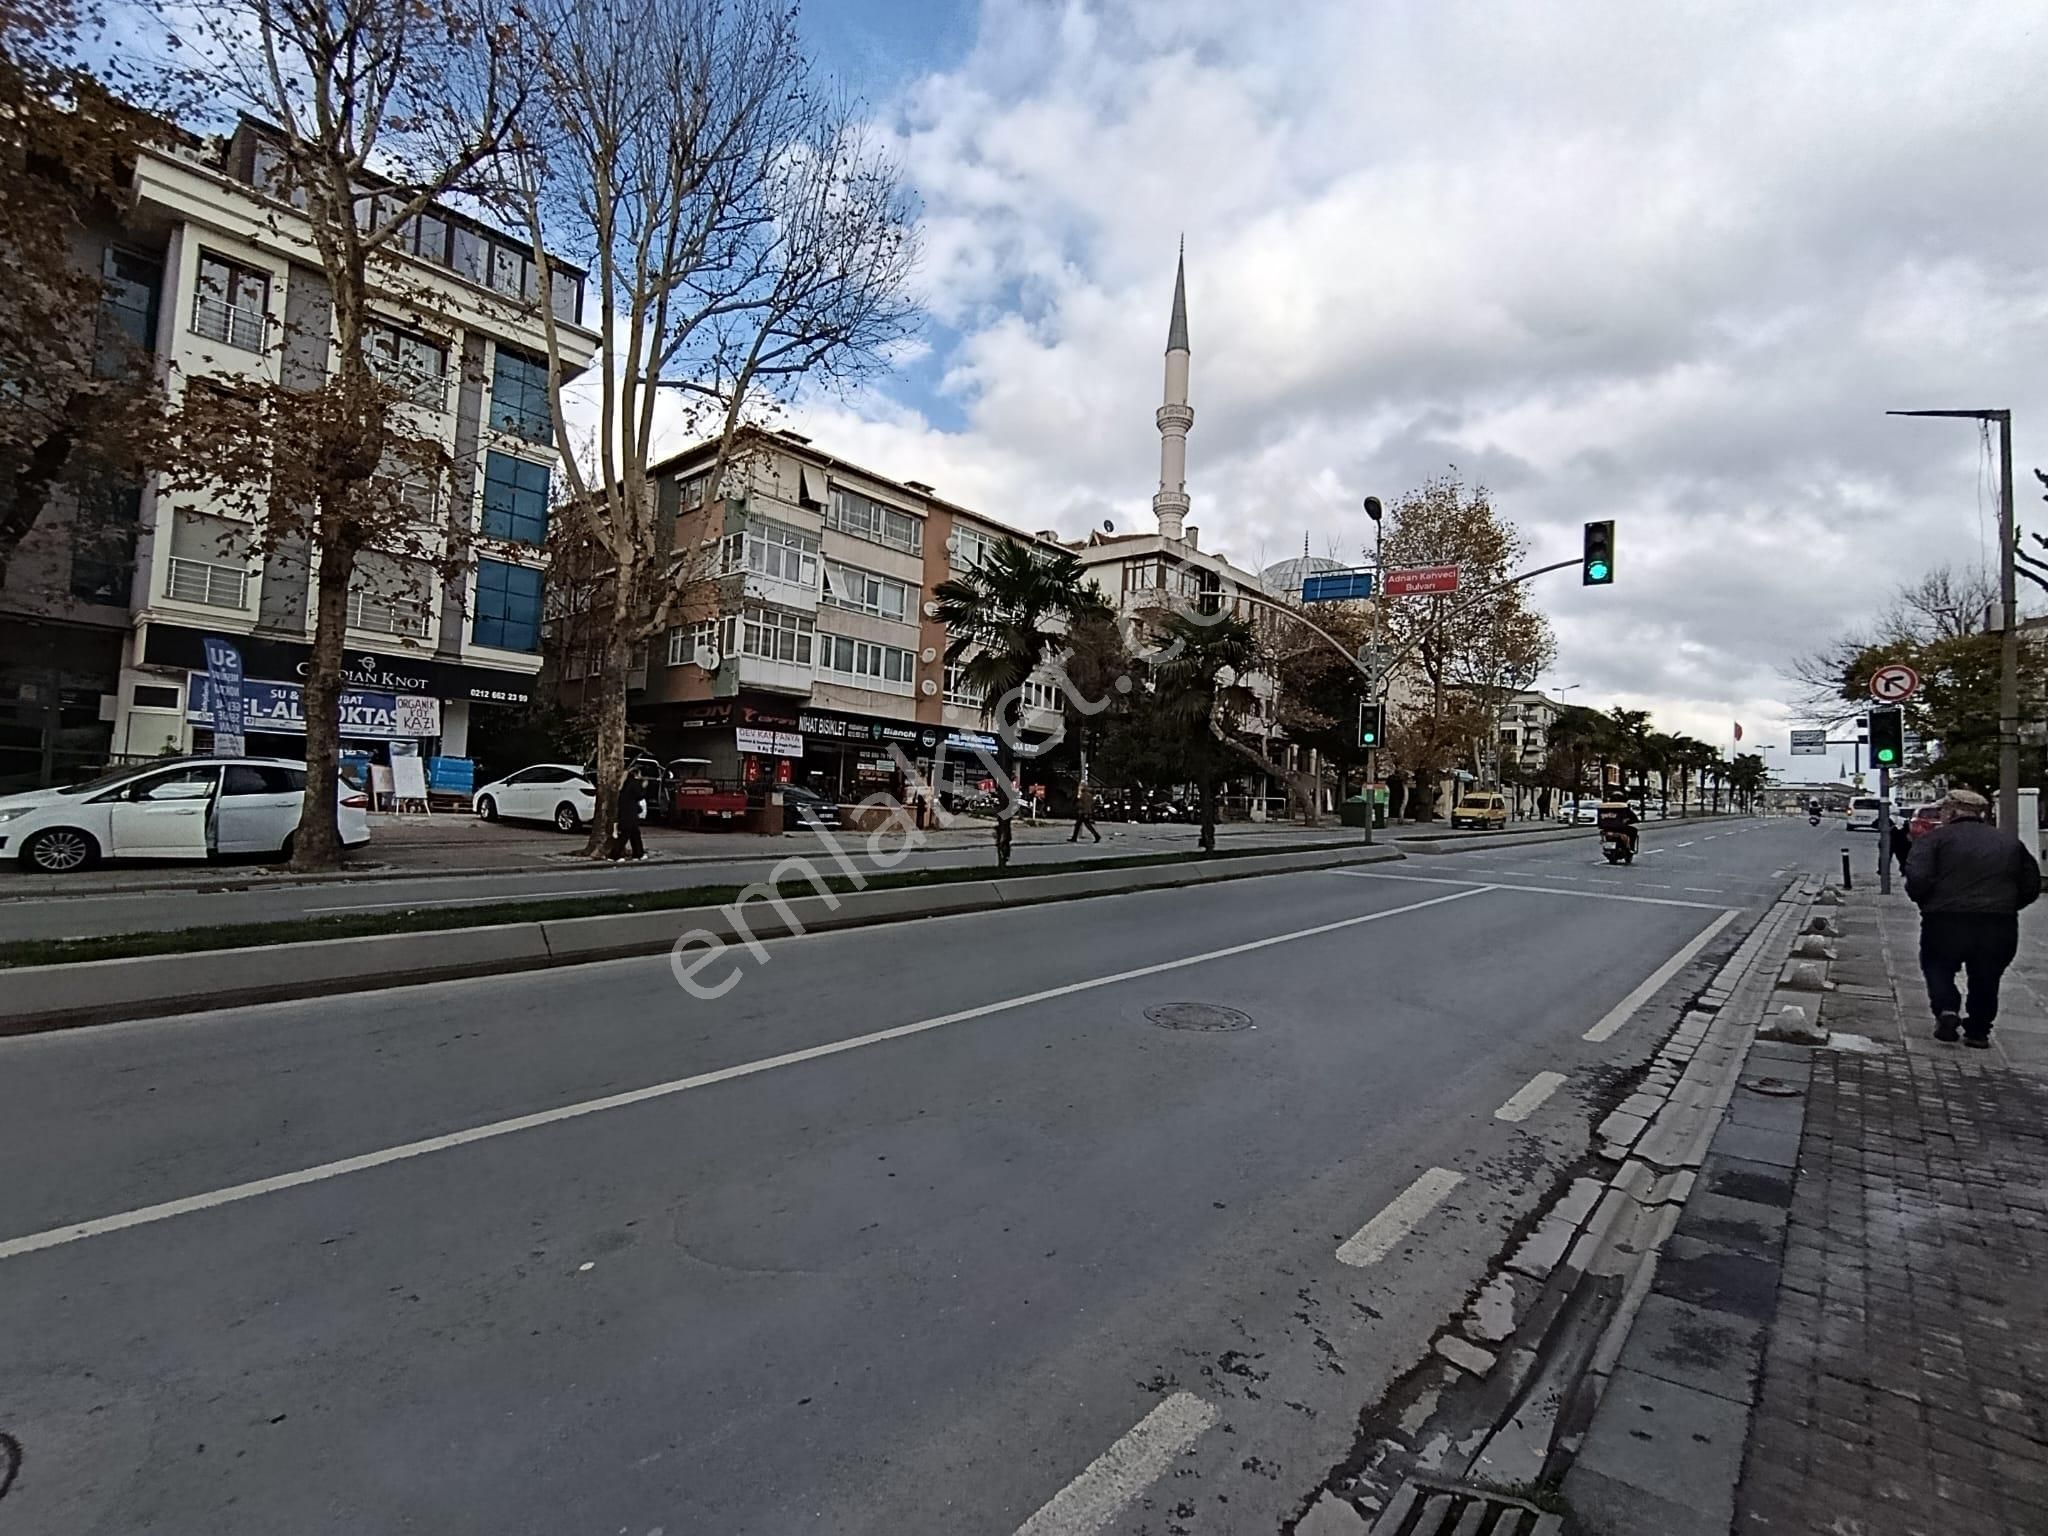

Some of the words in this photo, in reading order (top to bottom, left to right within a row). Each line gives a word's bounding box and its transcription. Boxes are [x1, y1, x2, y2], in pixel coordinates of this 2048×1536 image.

[1387, 574, 1418, 583] Adnan
[1420, 570, 1456, 580] Kahveci
[382, 671, 429, 689] KNOT
[270, 689, 289, 700] SU
[290, 690, 300, 701] &
[470, 688, 490, 698] 0212
[882, 727, 917, 738] Bianchi
